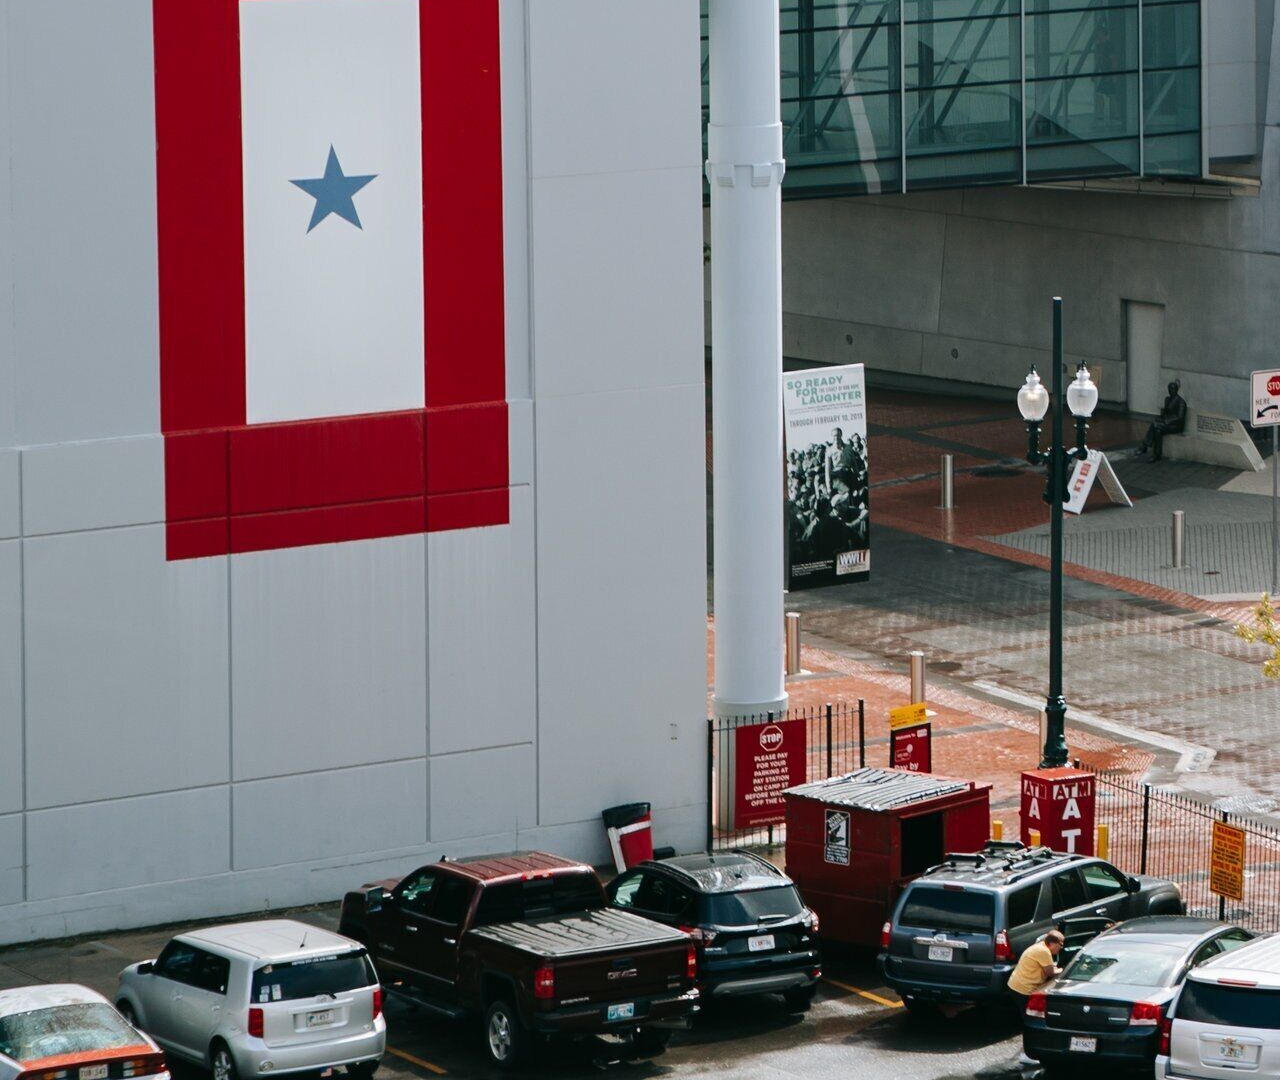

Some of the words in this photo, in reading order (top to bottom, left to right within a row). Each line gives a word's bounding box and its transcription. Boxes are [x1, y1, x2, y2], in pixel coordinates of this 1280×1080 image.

[787, 381, 802, 390] SO
[806, 375, 843, 388] READY
[796, 387, 818, 398] FOR
[801, 391, 862, 405] LAUGHTER
[1255, 398, 1270, 406] HERE
[790, 418, 813, 427] THROUGH
[814, 414, 840, 424] FEBRUARY
[761, 733, 781, 744] STOP
[754, 753, 776, 762] PLEASE
[777, 752, 788, 760] PAY
[756, 761, 769, 769] FOR
[770, 760, 787, 768] YOUR
[909, 761, 919, 771] by
[754, 768, 780, 777] PARKING
[781, 766, 788, 774] AT
[753, 777, 764, 785] PAY
[765, 774, 790, 783] STATION
[763, 783, 781, 791] CAMP
[1024, 779, 1047, 800] ATM
[1053, 780, 1091, 801] ATM
[745, 791, 768, 801] BEFORE
[751, 798, 764, 807] OFF
[765, 797, 777, 805] THE
